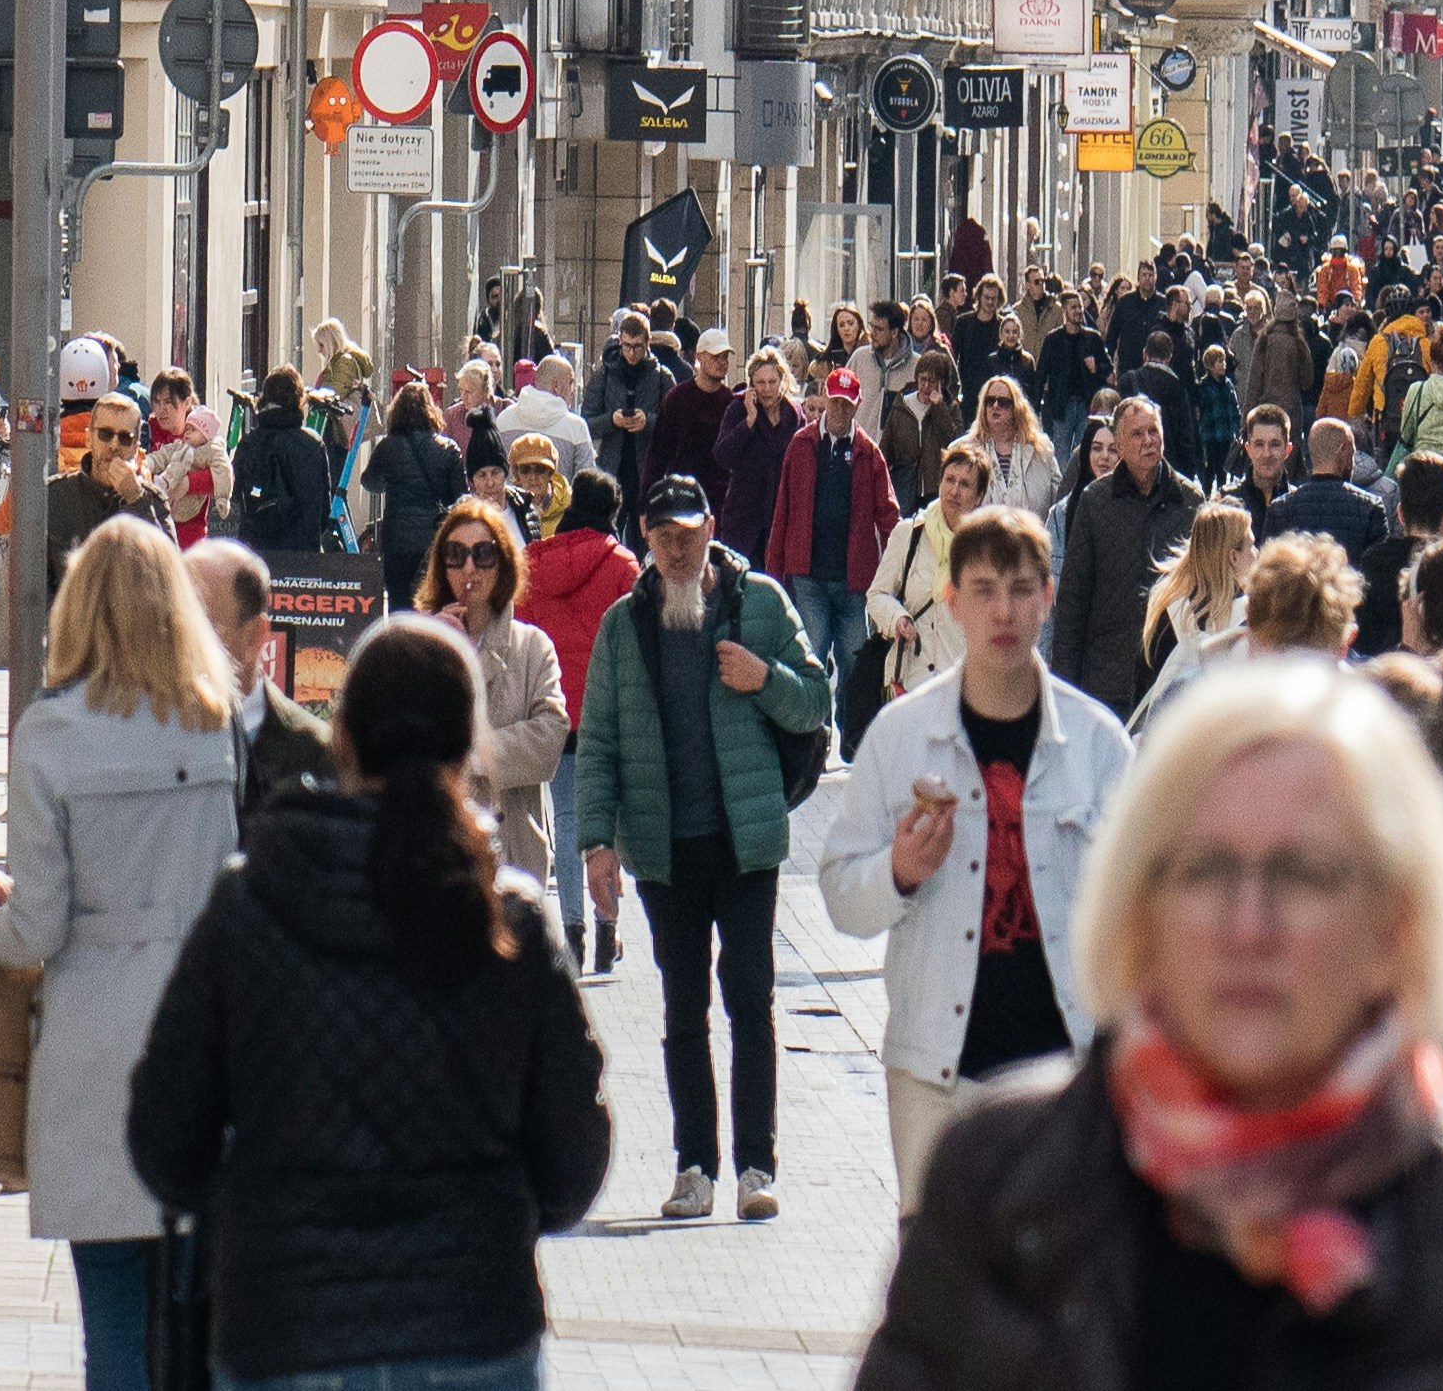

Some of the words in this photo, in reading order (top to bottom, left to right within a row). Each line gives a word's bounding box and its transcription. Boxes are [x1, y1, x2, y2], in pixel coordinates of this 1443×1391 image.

[1019, 18, 1061, 27] DAKINI
[1310, 28, 1351, 41] TATTOO
[1092, 61, 1118, 69] ARNIA
[957, 77, 1012, 103] OLIVIA
[1078, 86, 1118, 97] TANDYR
[640, 116, 689, 129] SALEWA
[356, 132, 375, 143] Nie
[1149, 128, 1173, 147] 66
[649, 272, 677, 285] SALEWA
[268, 578, 362, 591] SMACZNIEJSZE
